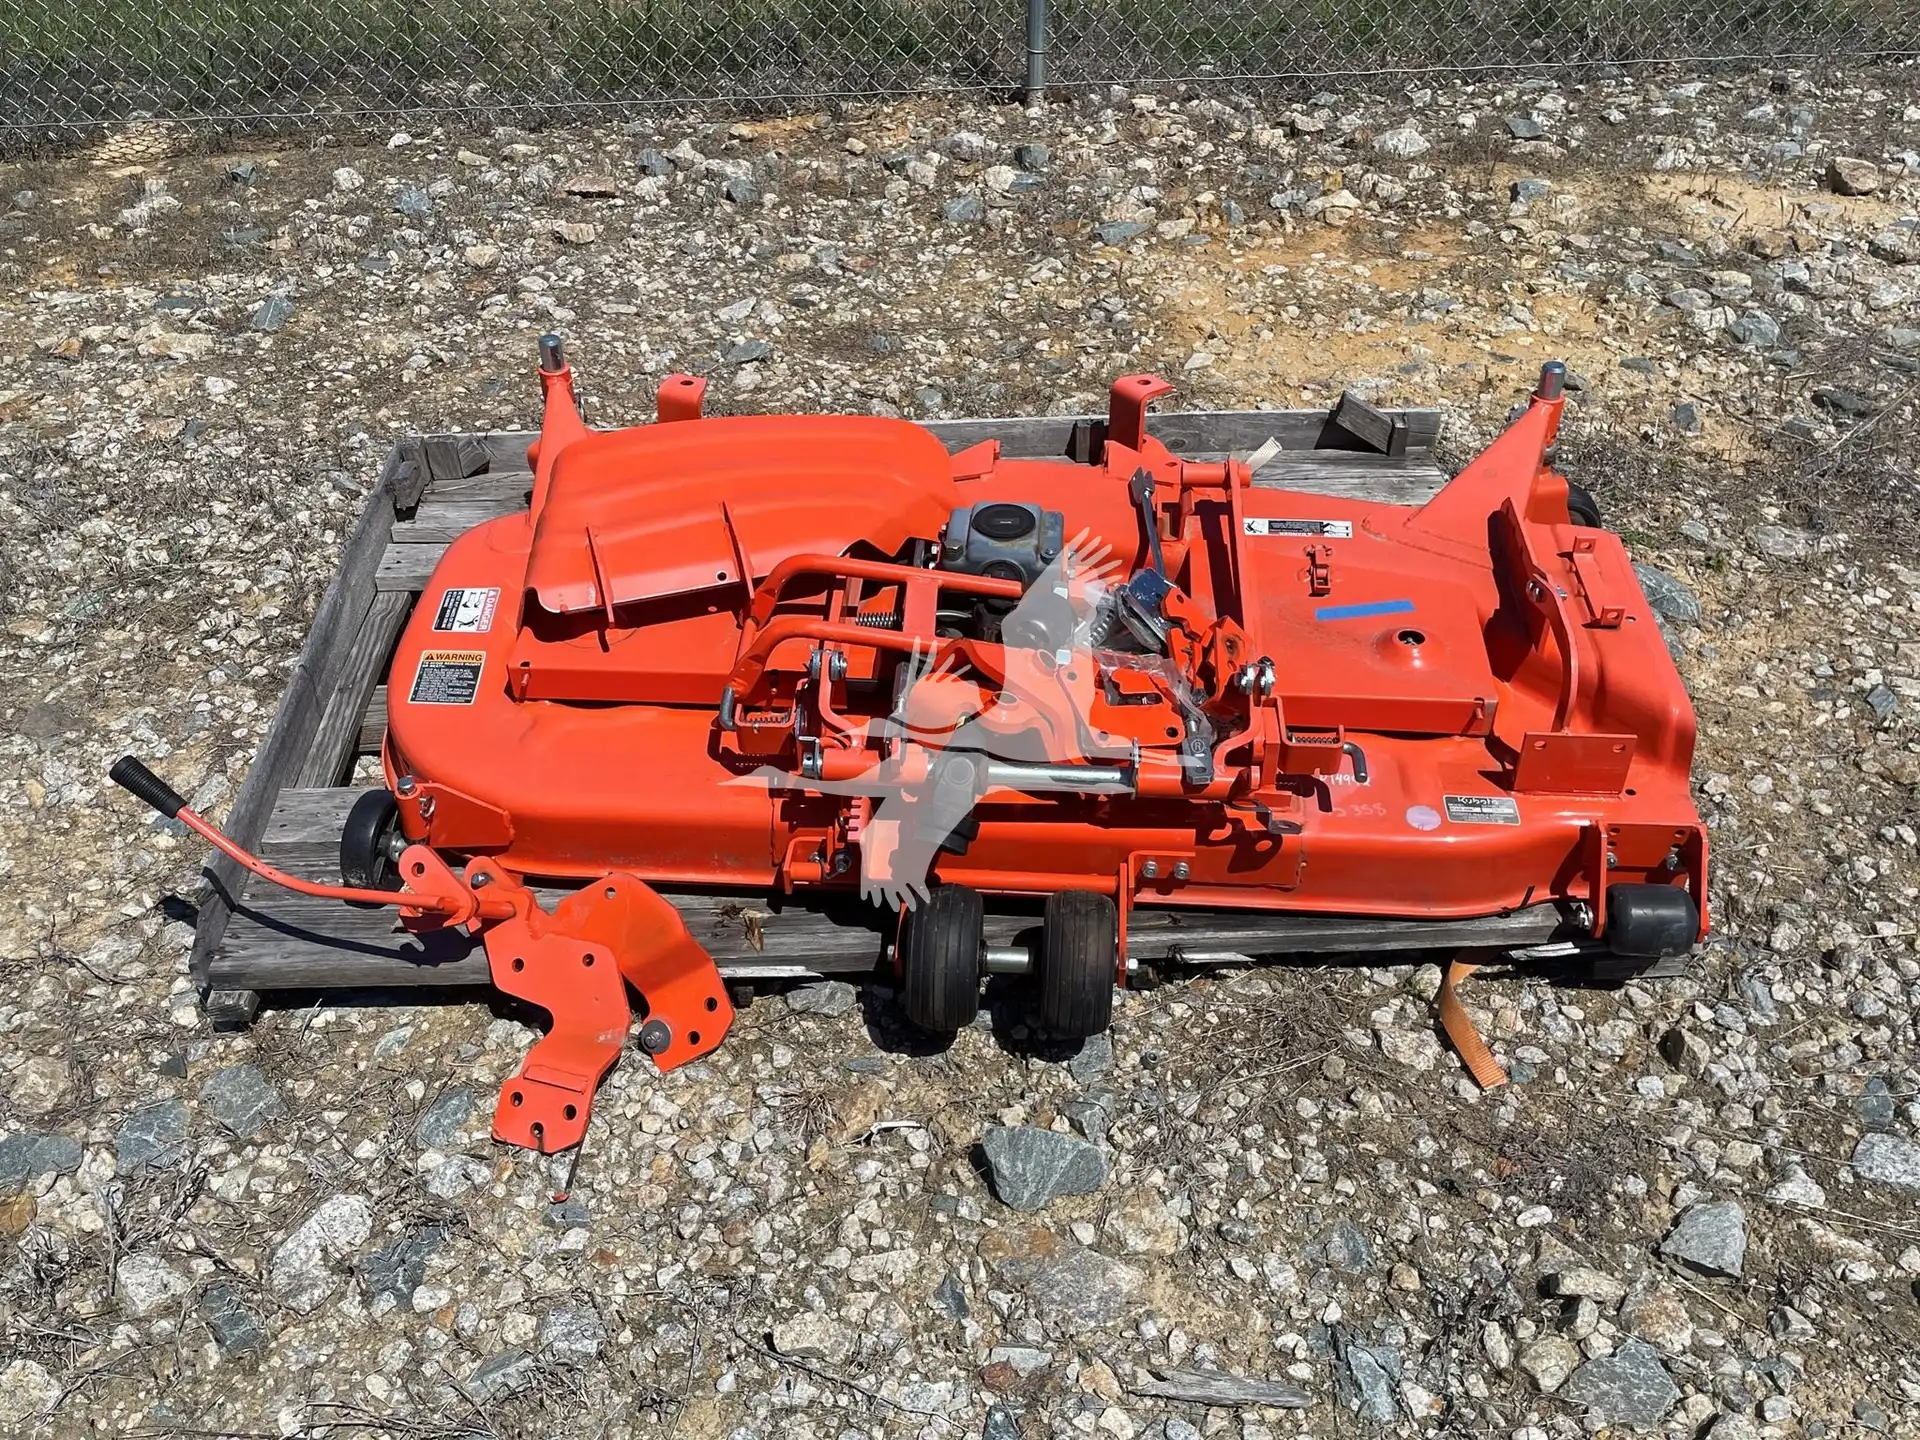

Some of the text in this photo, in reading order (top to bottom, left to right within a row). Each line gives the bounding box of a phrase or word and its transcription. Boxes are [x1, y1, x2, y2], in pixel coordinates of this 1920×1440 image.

[479, 597, 494, 630] DANGER
[436, 653, 482, 662] WARNING
[1457, 796, 1499, 805] Kubota
